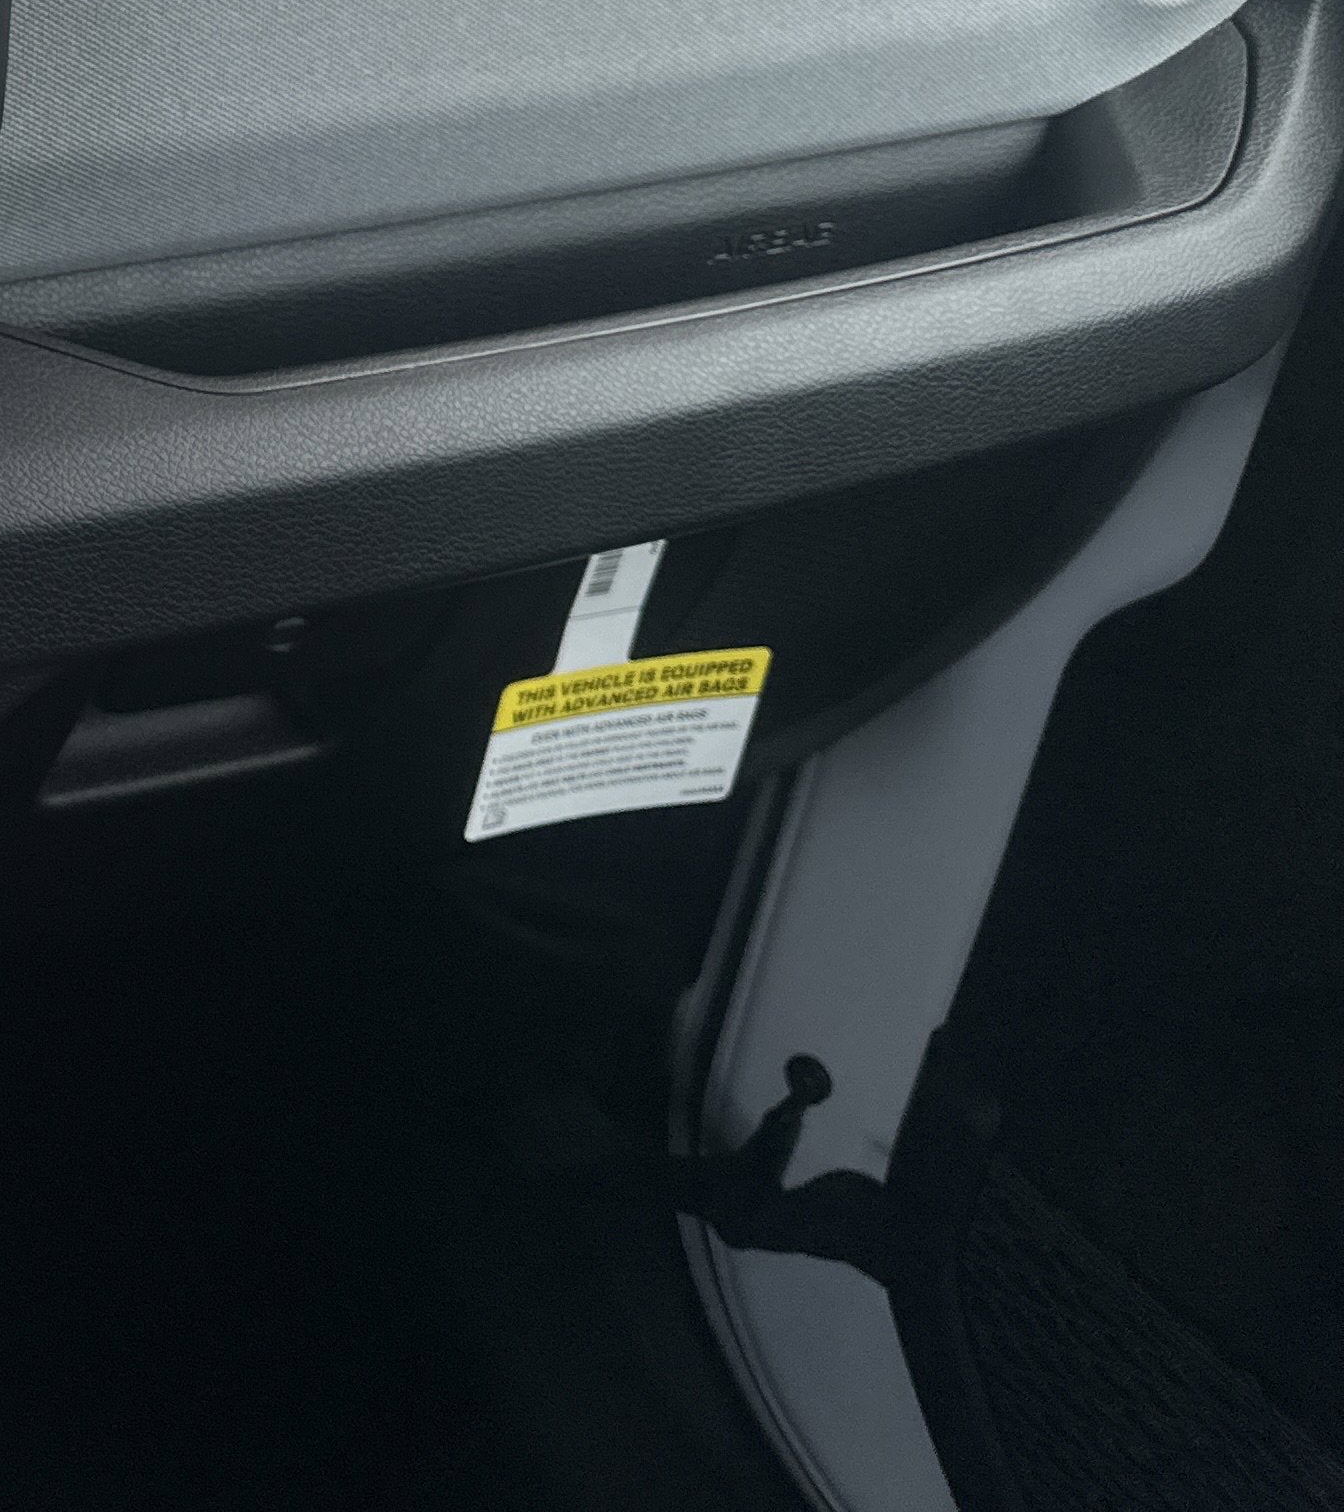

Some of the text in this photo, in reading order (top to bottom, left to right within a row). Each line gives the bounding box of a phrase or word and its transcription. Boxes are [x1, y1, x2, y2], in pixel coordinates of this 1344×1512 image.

[512, 703, 556, 724] WITH
[563, 686, 659, 713] ADVANCED
[663, 681, 694, 699] AIR
[517, 687, 554, 705] THIS
[561, 670, 634, 697] VEHICLE
[660, 658, 753, 682] EQUIPPED
